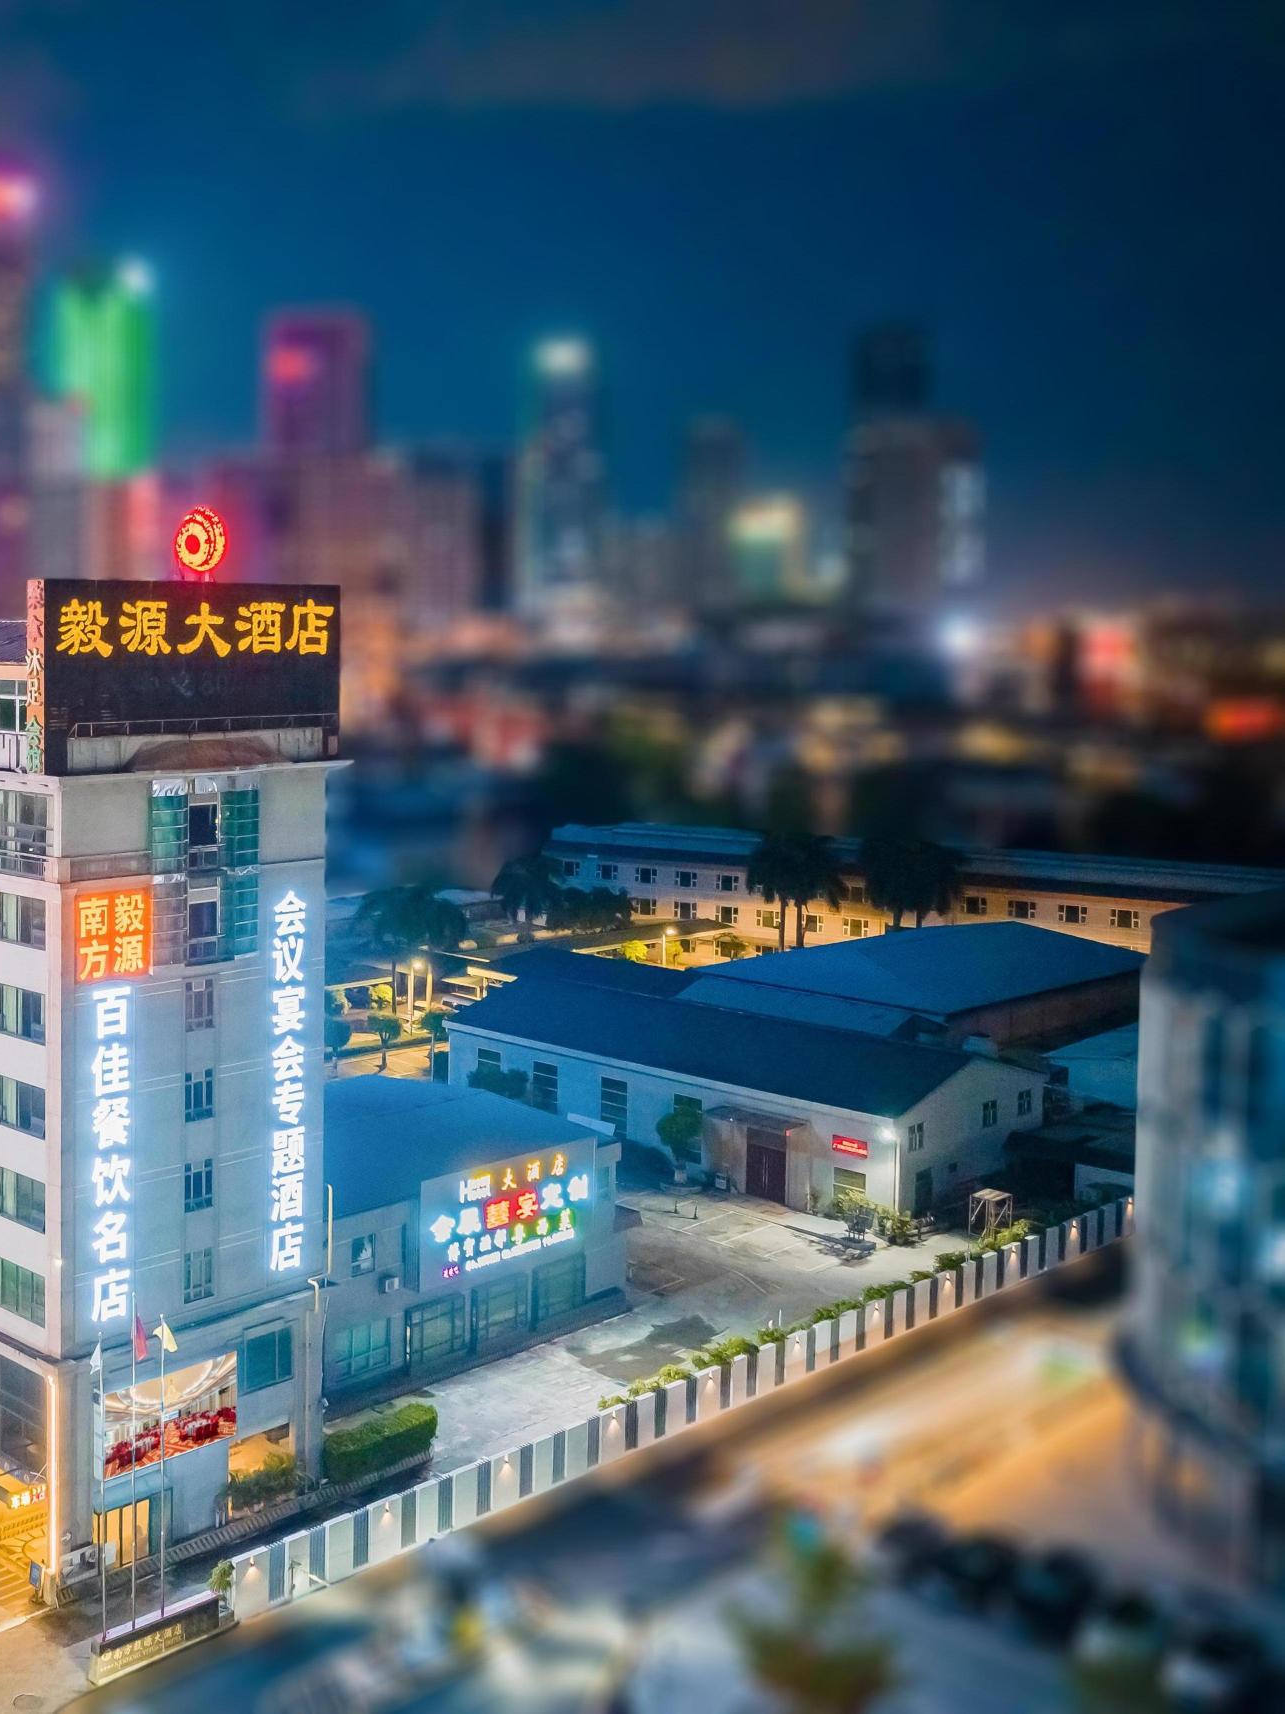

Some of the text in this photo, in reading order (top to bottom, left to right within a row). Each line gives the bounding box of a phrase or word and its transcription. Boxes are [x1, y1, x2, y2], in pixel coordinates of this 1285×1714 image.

[55, 598, 336, 658] 毅源大酒店
[91, 985, 130, 1322] 百佳餐饮名店
[271, 890, 306, 1272] 会议宴会专题酒店
